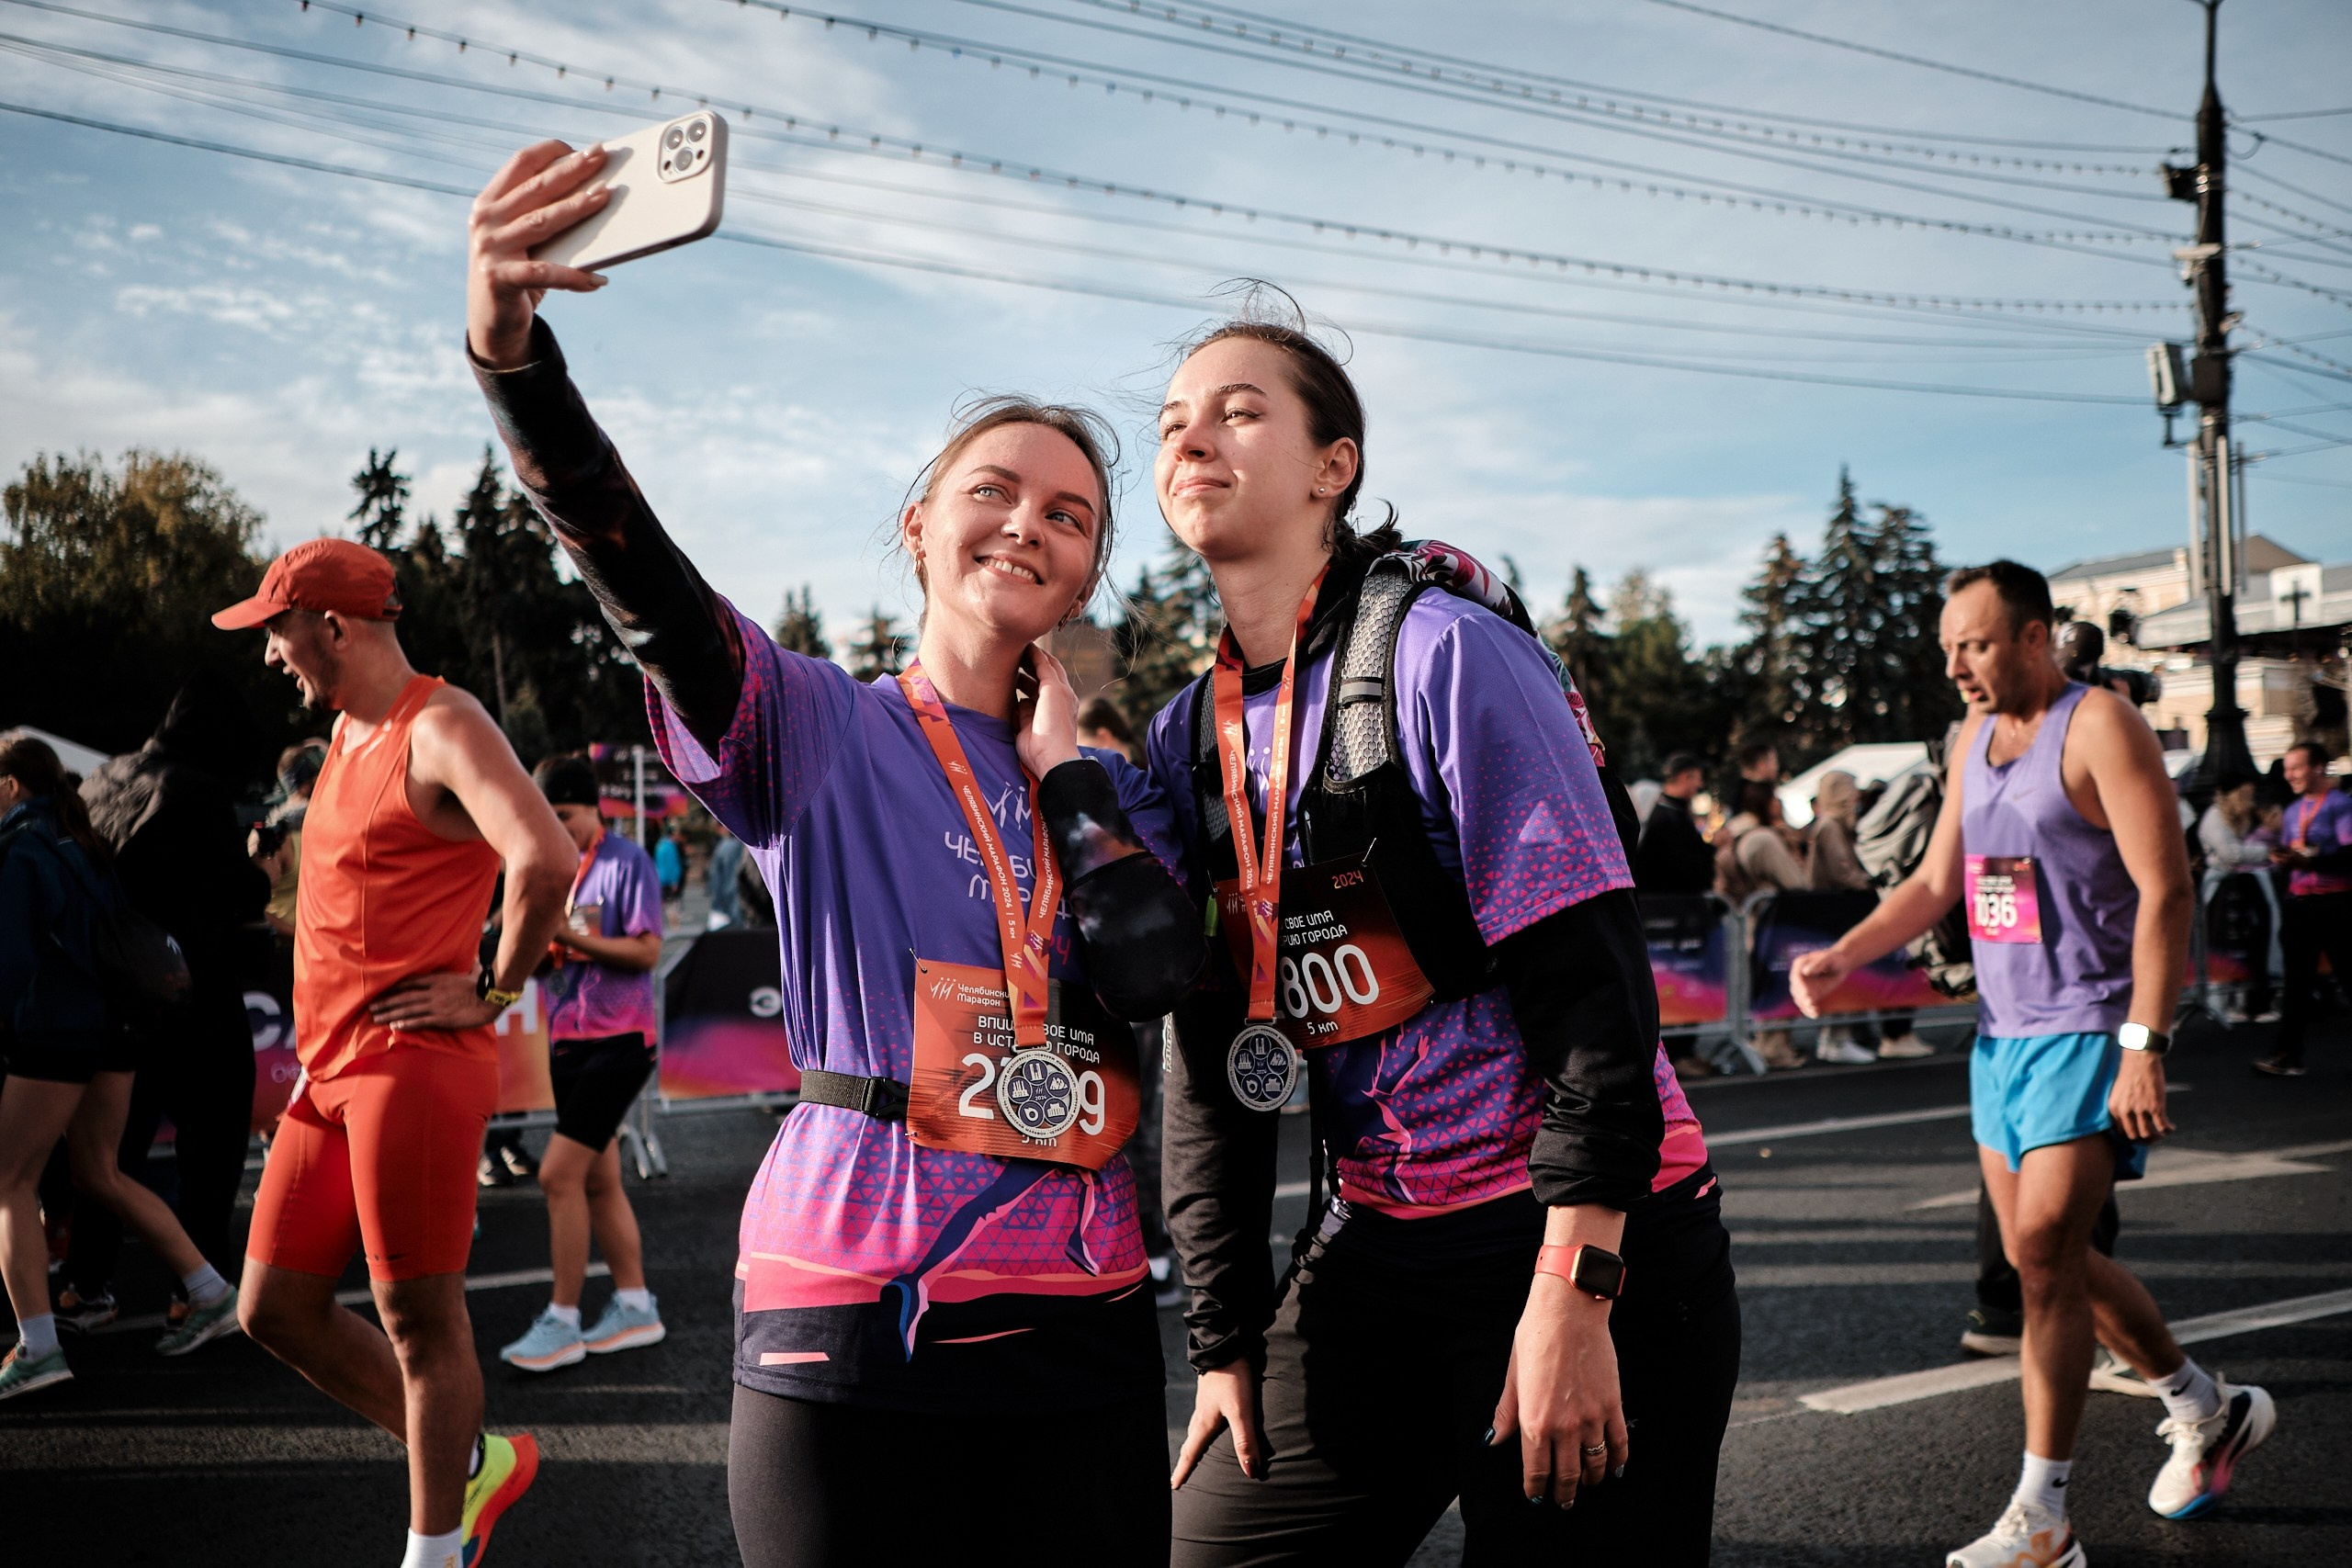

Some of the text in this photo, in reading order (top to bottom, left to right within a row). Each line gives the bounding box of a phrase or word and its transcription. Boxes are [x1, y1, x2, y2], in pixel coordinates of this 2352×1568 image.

[1229, 750, 1244, 819] ЧЕЛЯБИНСКИЙ
[1238, 819, 1251, 867] МАРАФОН
[1267, 811, 1279, 885] ЧЕЛЯБИНСКИЙ
[1273, 760, 1283, 809] МАРАФОН
[963, 784, 992, 843] ЧЕЛЯБИНСКИЙ
[986, 842, 1008, 886] МАРАФОН
[1001, 886, 1012, 908] 2024
[1042, 821, 1051, 858] МАРАФОН
[1039, 858, 1054, 919] ЧЕЛЯБИНСКИЙ
[1332, 870, 1364, 889] 2024
[1279, 923, 1349, 947] ОРИЮ ГОРОДА
[1284, 909, 1335, 930] СВОЕ ИМЯ
[957, 983, 1010, 998] Челябински
[1275, 943, 1380, 1020] 800
[957, 993, 1001, 1007] Марафон
[1043, 1023, 1066, 1038] ВОЕ
[1069, 1028, 1094, 1045] ИМЯ
[1306, 1021, 1339, 1035] 5 км
[974, 1032, 983, 1043] В
[1057, 1042, 1100, 1065] ГОРОДА
[959, 1053, 1105, 1135] 29
